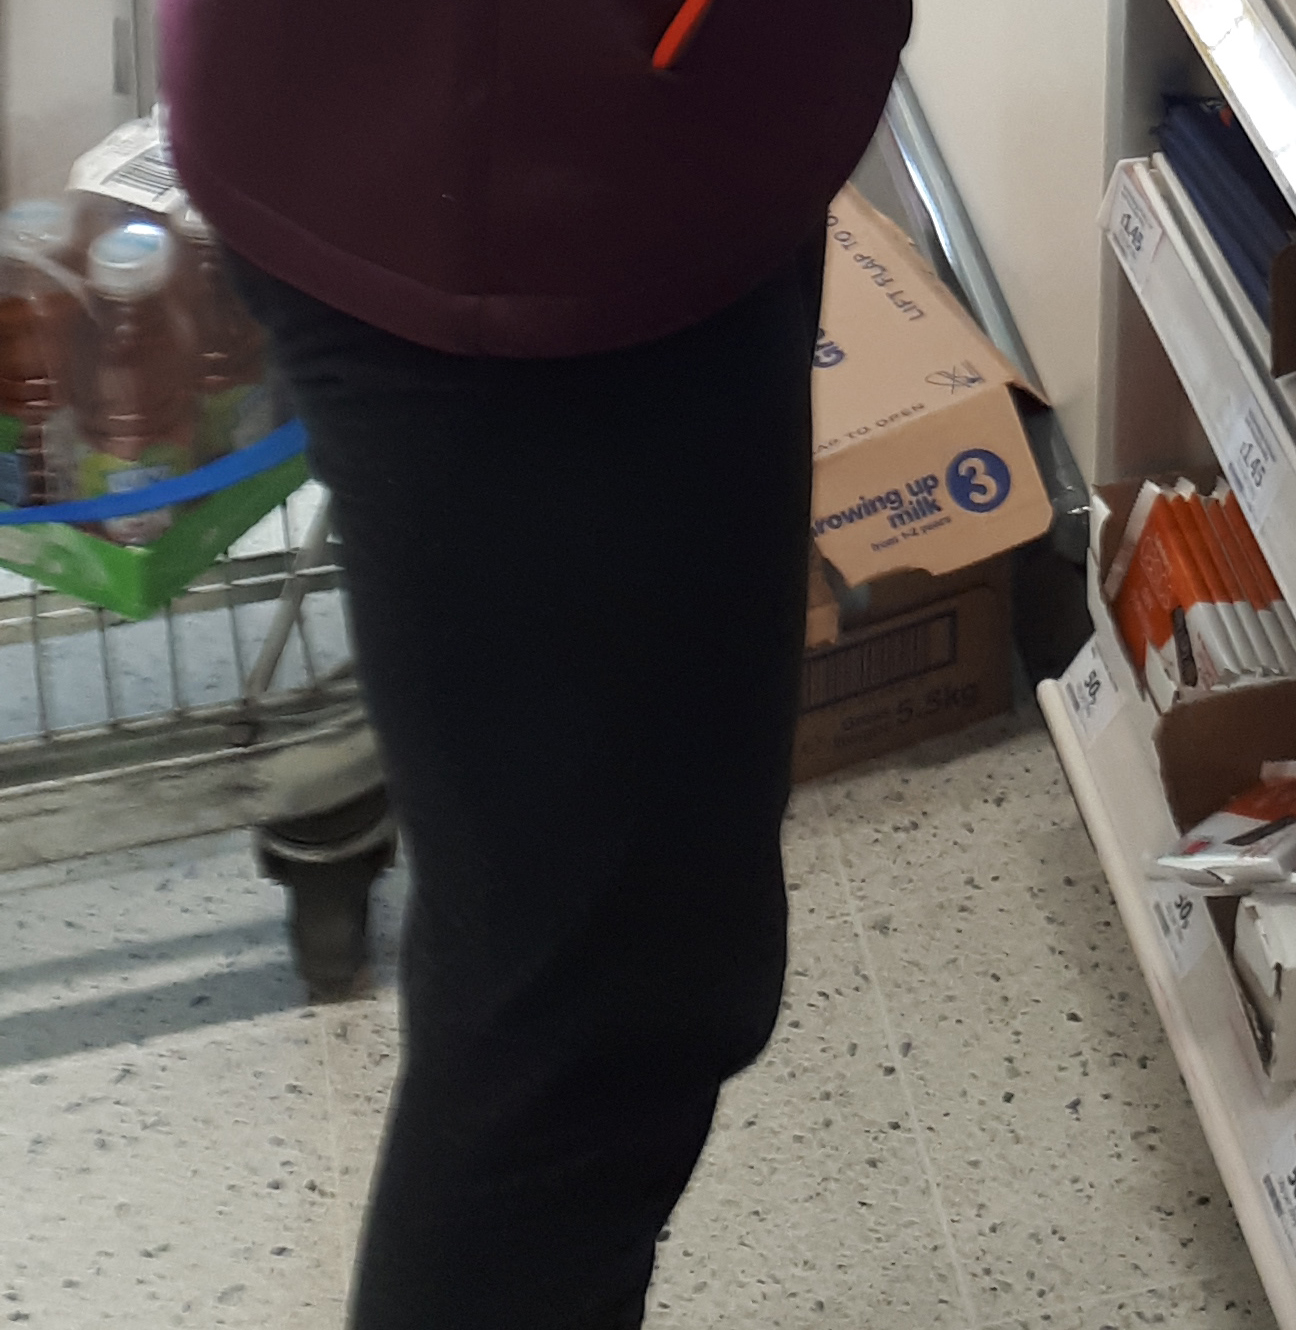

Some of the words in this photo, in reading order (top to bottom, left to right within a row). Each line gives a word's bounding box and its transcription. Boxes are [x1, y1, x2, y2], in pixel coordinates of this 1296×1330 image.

[833, 229, 858, 252] TO
[852, 251, 895, 289] FLAP
[886, 288, 925, 323] LIFT
[844, 427, 869, 441] TO
[875, 402, 926, 429] OPEN
[957, 456, 998, 506] 3
[1240, 440, 1267, 489] £1.45
[810, 491, 905, 539] rowing
[905, 473, 940, 503] up
[888, 495, 943, 530] milk
[870, 532, 899, 553] from
